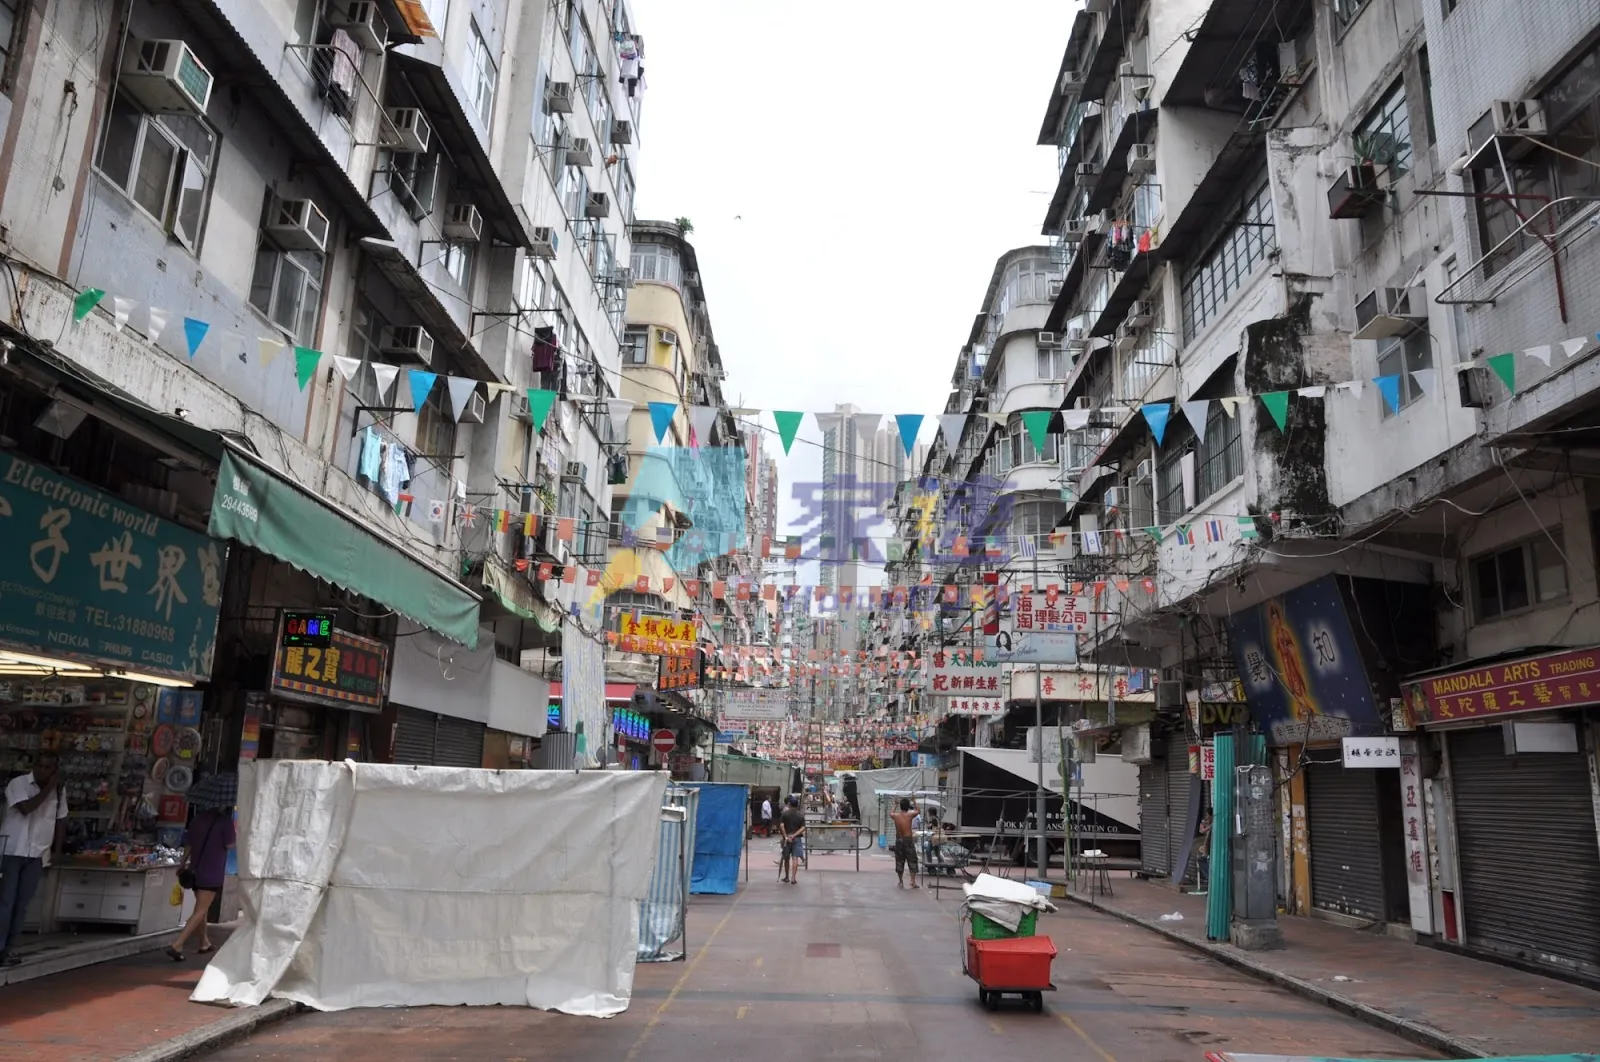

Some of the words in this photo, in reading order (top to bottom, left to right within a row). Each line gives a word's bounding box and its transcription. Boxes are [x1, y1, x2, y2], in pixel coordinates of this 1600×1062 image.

[6, 456, 108, 518] Electronic
[112, 507, 159, 537] world
[1035, 609, 1087, 624] 理髮公司
[287, 618, 330, 636] GAME
[48, 630, 89, 648] NOKIA
[142, 649, 174, 665] CASIO
[1313, 631, 1336, 666] 知
[1433, 671, 1494, 695] MANDALA
[1503, 661, 1541, 682] ARTS
[1549, 657, 1595, 675] TRADING
